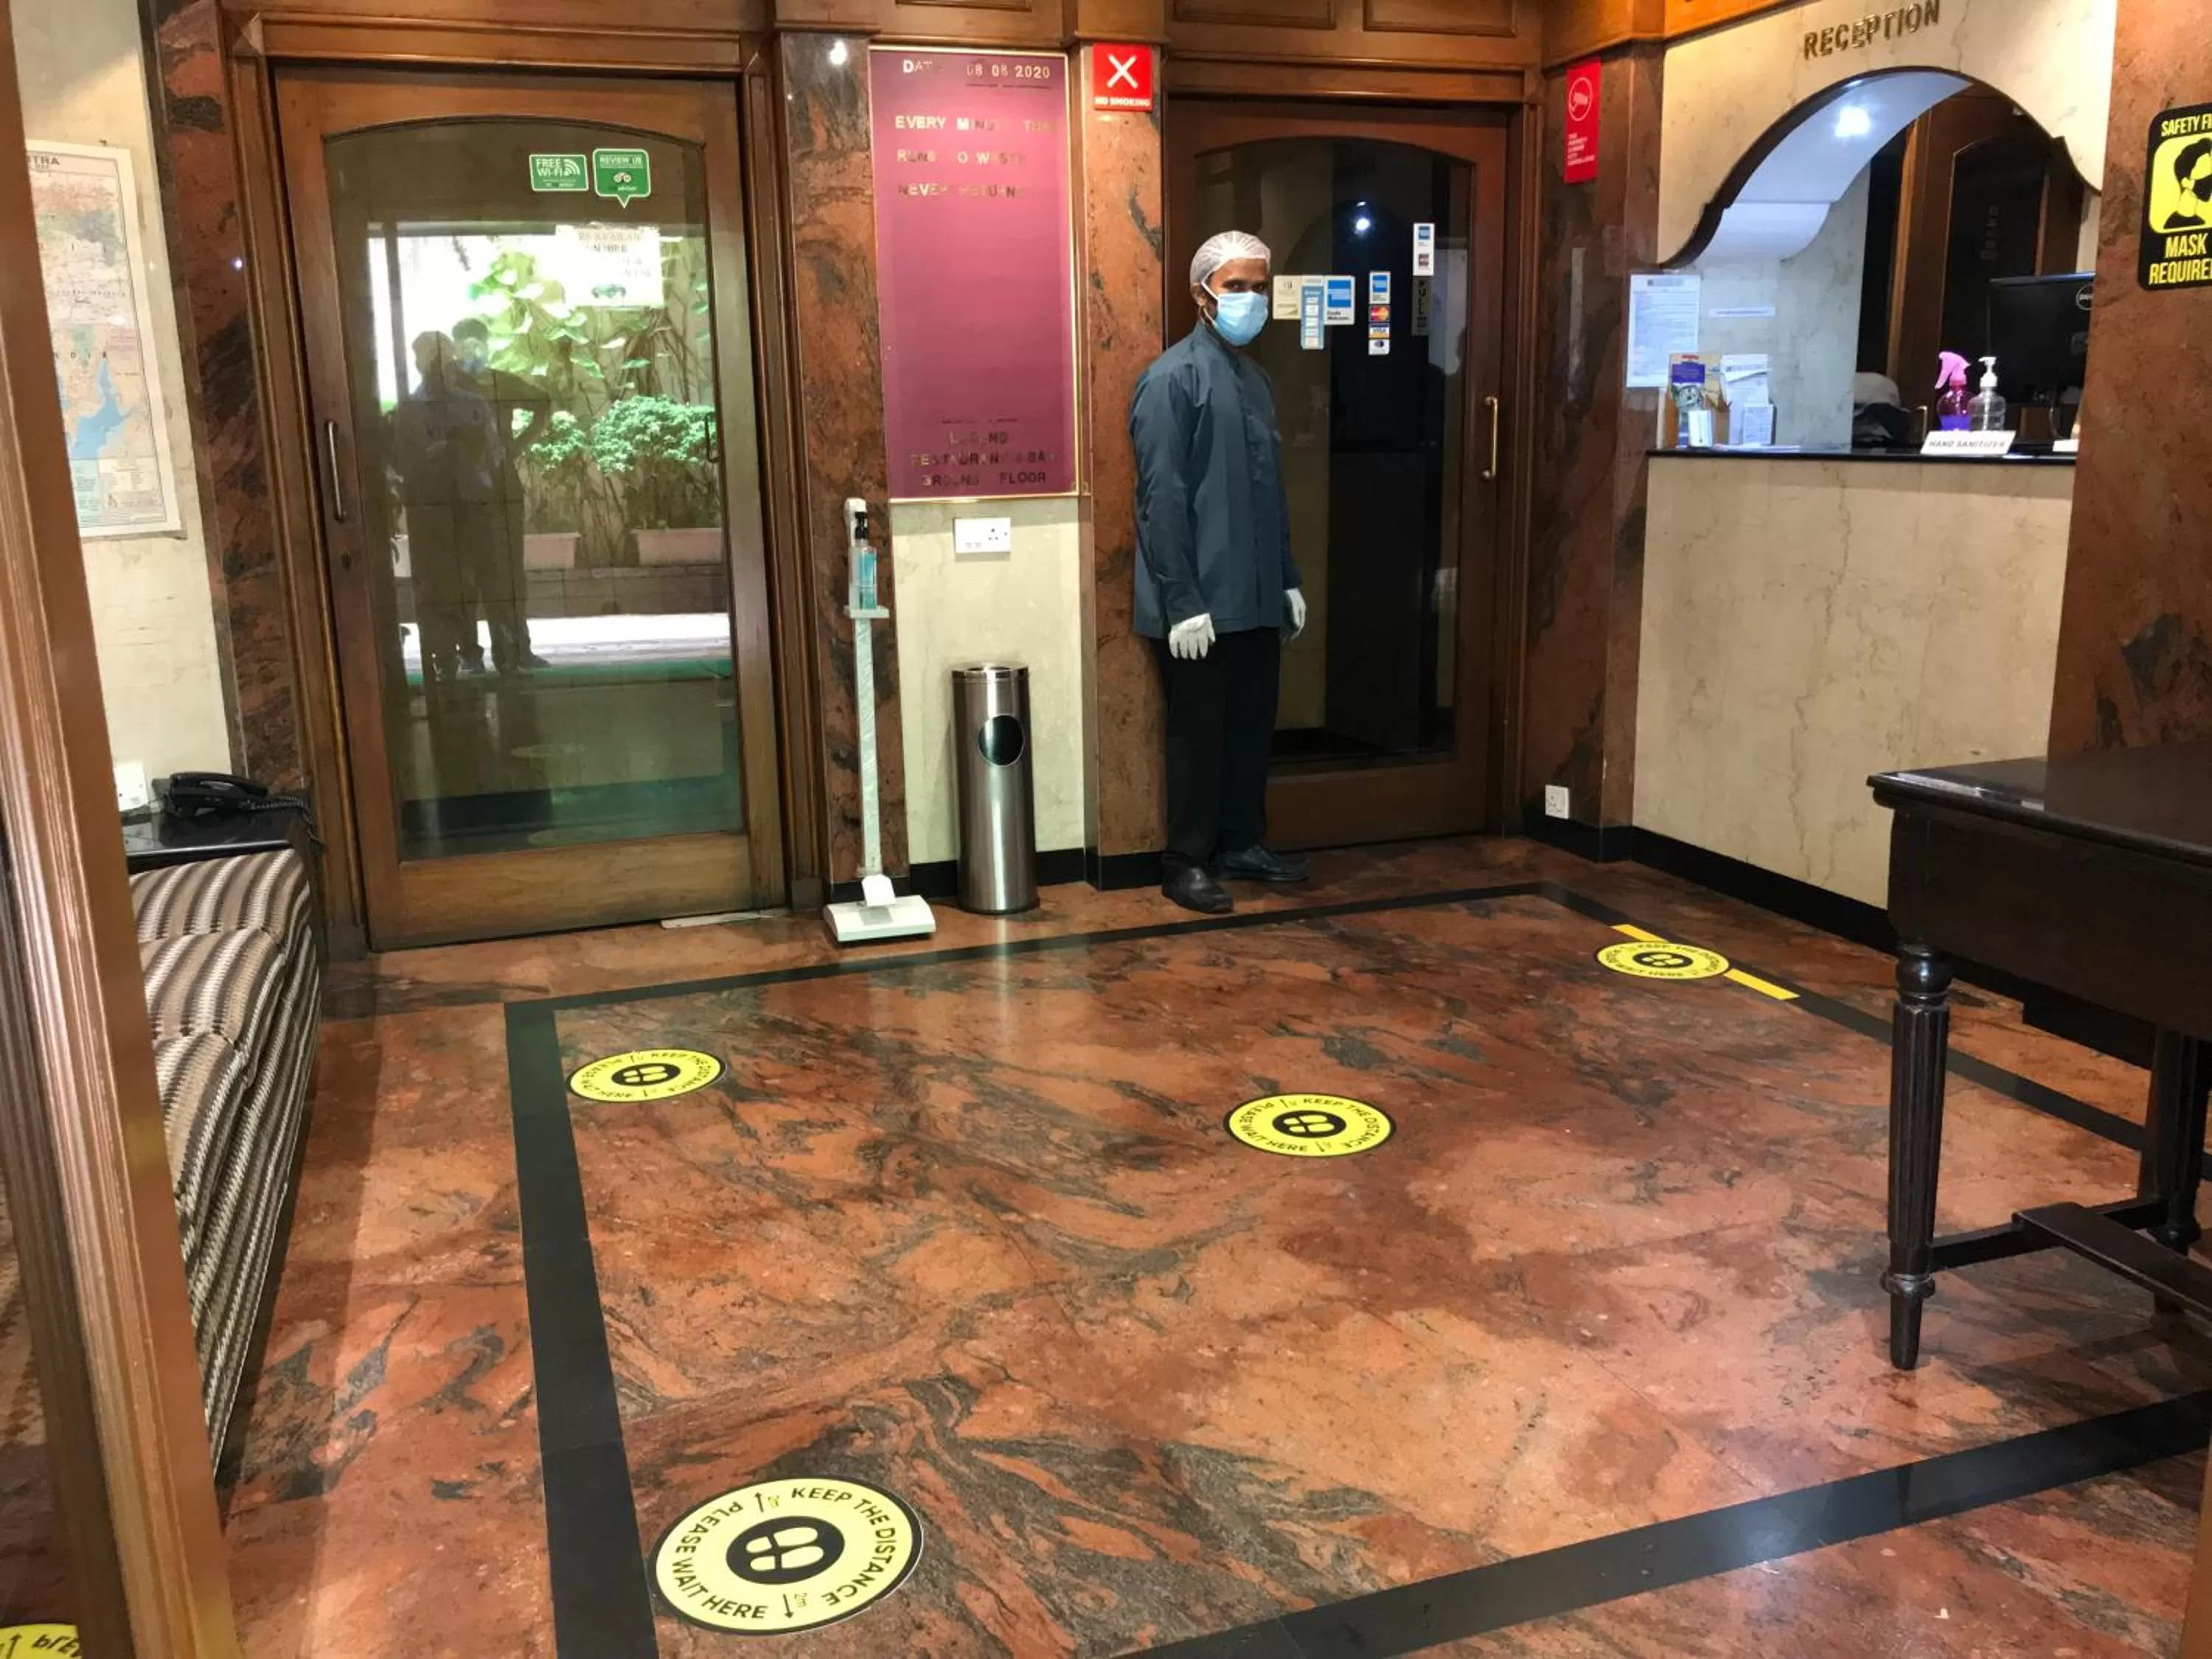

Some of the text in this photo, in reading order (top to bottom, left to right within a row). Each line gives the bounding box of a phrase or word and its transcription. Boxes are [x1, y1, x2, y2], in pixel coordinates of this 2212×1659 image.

[1804, 0, 1940, 60] RECEPTION
[1015, 65, 1050, 79] 2020
[895, 116, 946, 131] EVERY
[2161, 115, 2200, 136] SAFETY
[536, 158, 561, 167] FREE
[599, 155, 629, 164] REVIEW
[2165, 232, 2208, 258] MASK
[2149, 258, 2212, 285] REQUIRE
[999, 472, 1046, 484] FLOOR
[1265, 1140, 1308, 1152] HERE
[791, 1486, 897, 1607] KEEP THE DISTANCE
[672, 1500, 769, 1620] PLEASE WAIT HERE
